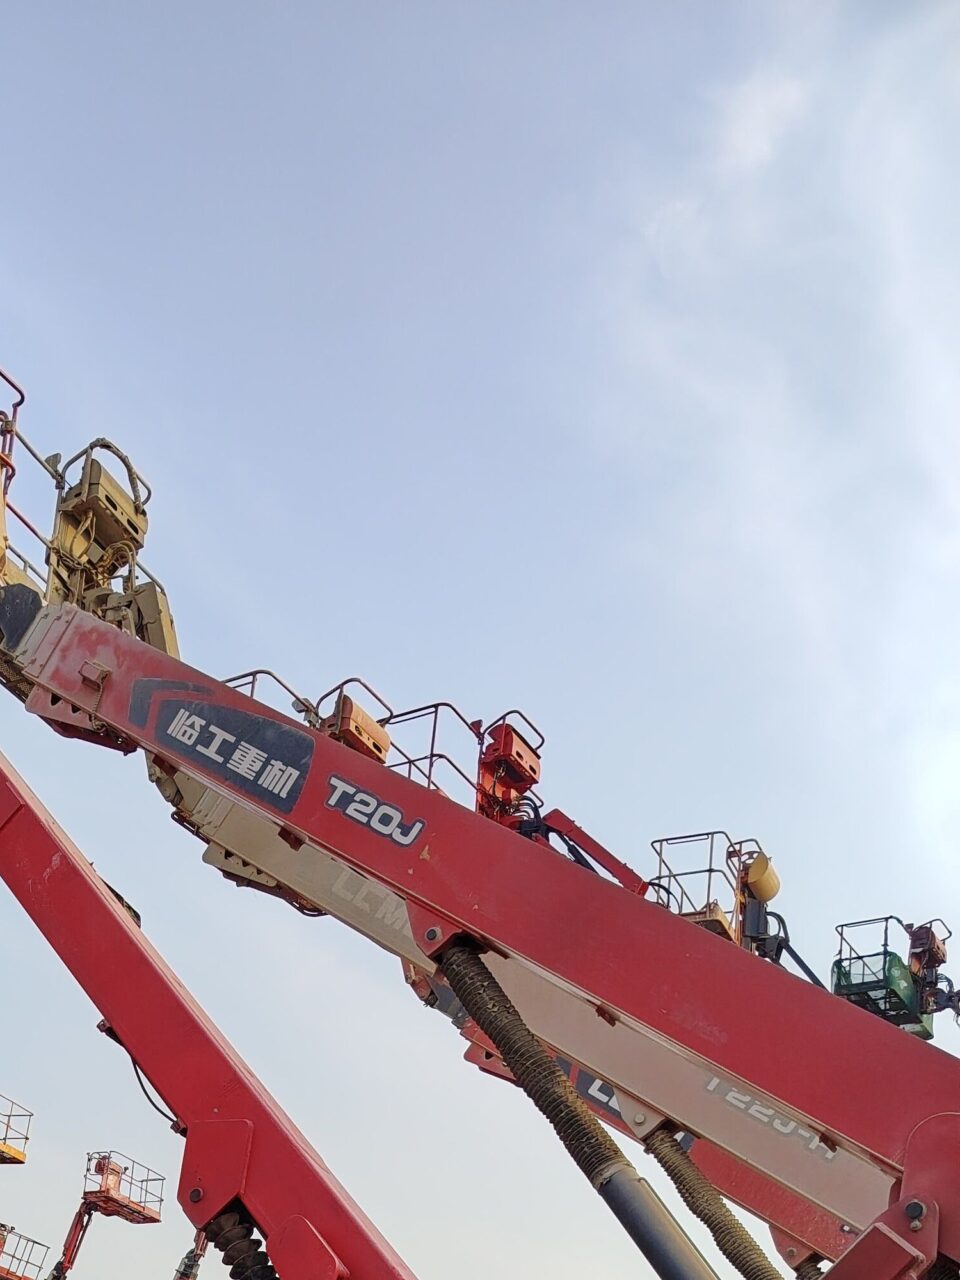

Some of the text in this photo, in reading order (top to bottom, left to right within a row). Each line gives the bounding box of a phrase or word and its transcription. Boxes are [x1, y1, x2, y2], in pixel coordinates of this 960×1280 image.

[166, 708, 300, 799] 临工重机
[327, 777, 423, 845] T20J
